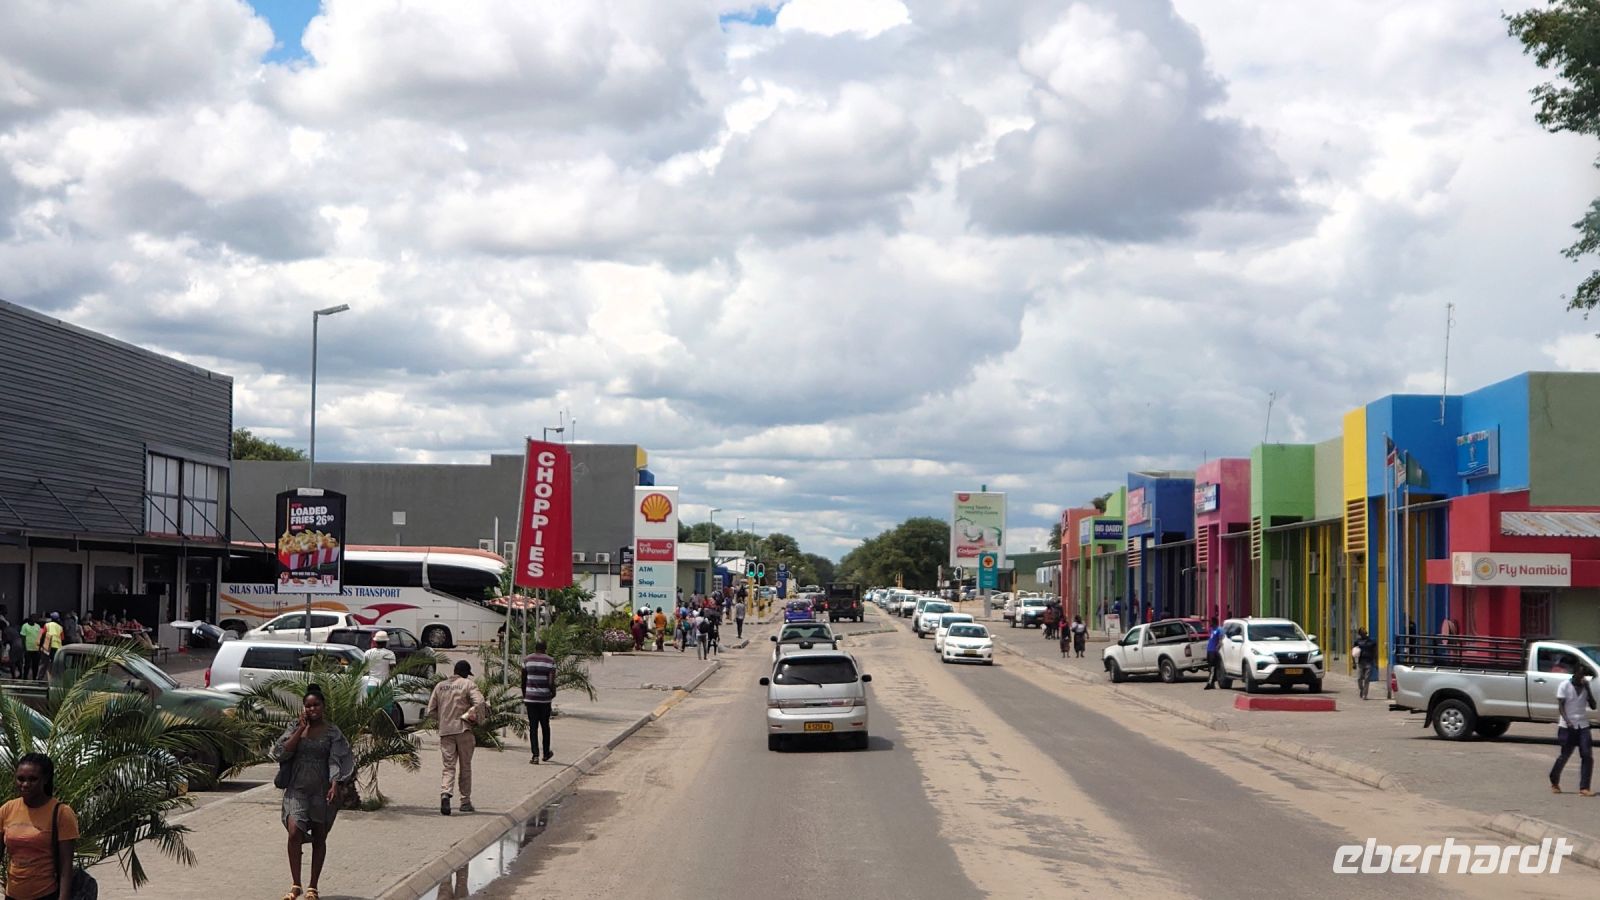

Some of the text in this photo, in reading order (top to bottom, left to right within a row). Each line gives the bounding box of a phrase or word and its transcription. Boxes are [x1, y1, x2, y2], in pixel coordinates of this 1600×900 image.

[291, 506, 328, 516] LOADED
[527, 451, 556, 577] CHOPPIES
[291, 515, 315, 525] FRIES
[639, 546, 670, 554] V-Power
[1498, 564, 1568, 578] Fly Namibia
[638, 578, 655, 587] Shop
[229, 584, 251, 595] SILAS
[354, 587, 402, 598] TRANSPORT
